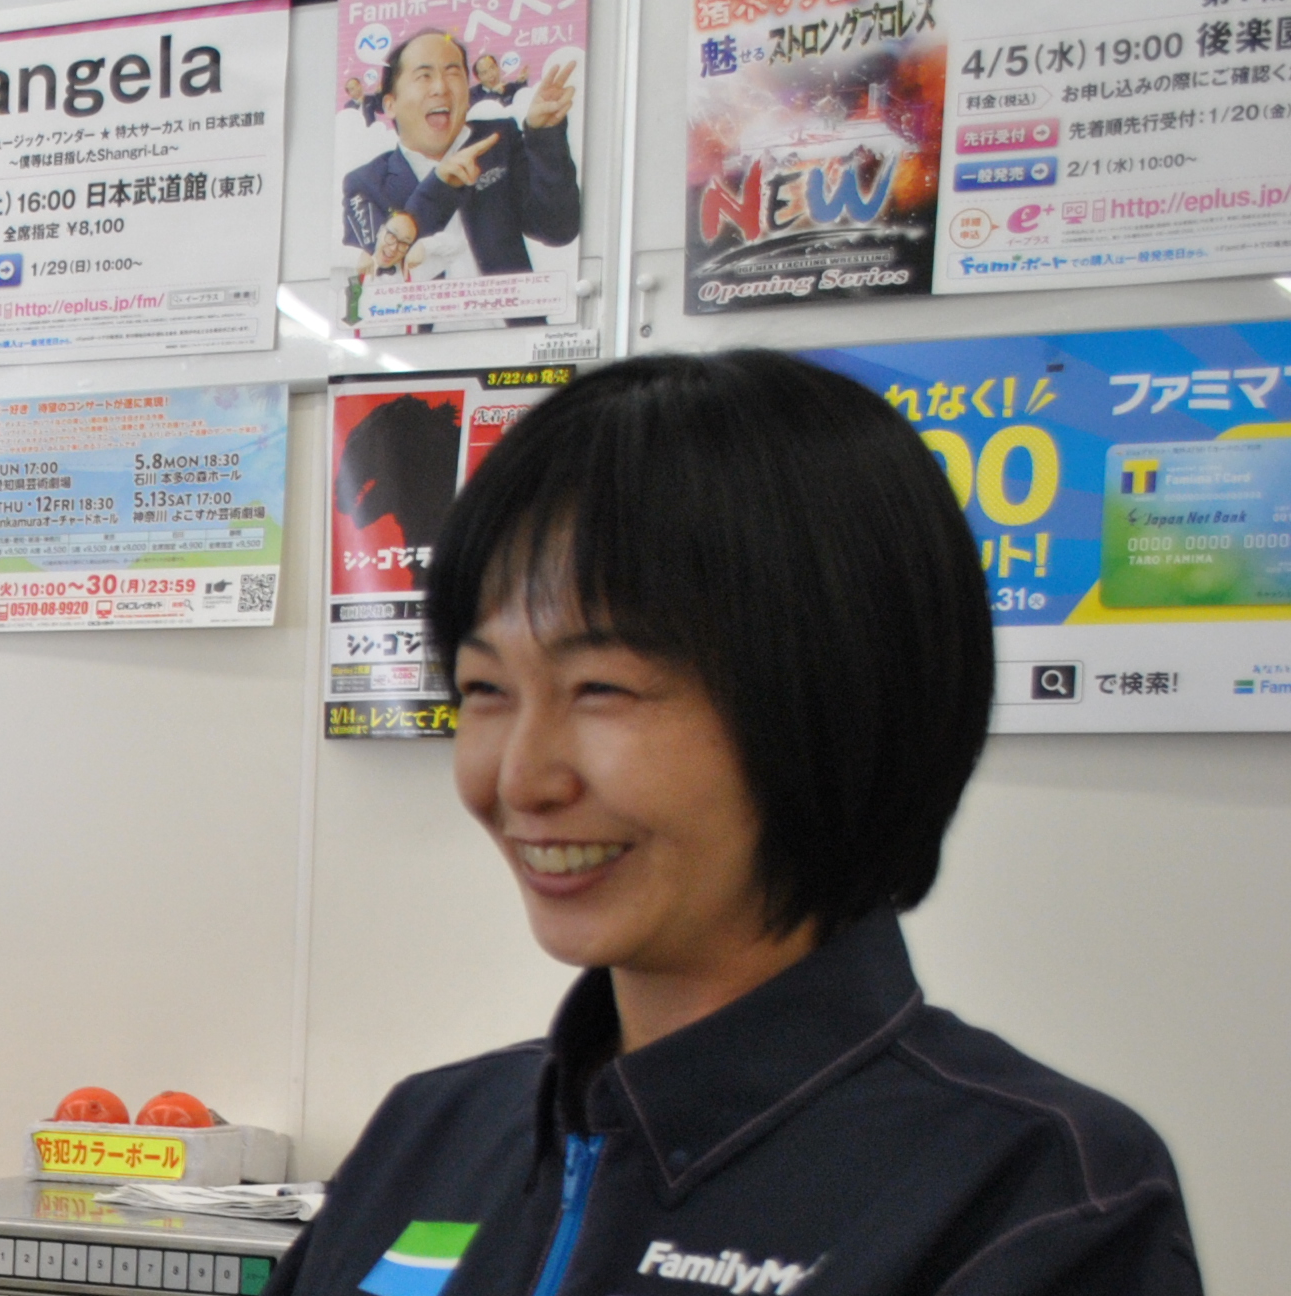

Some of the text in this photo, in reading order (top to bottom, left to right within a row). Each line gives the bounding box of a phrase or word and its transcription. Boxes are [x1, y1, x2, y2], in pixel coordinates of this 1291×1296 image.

[514, 25, 573, 47] と購入!
[700, 35, 765, 78] 魅せる
[1095, 32, 1183, 66] 19:00
[966, 62, 1291, 110] 料金(税込) お申し込みの際にご確認く
[116, 120, 184, 140] 特大サーカス
[205, 111, 266, 131] 日本武道館
[964, 129, 1026, 146] 先行受付
[961, 168, 1025, 183] 一般発売
[18, 189, 76, 214] 16:00
[700, 147, 898, 246] NEW
[3, 218, 125, 243] 全席指定 ¥8,100
[698, 268, 909, 303] Opening Series
[14, 293, 165, 318] http://eplus.jp/fm/
[24, 461, 58, 474] 17:00
[204, 453, 239, 467] 18:30
[134, 470, 242, 486] 石川 本多の森ホール
[79, 497, 113, 510] 18:30
[197, 492, 232, 505] 17:00
[133, 506, 265, 523] 神奈川 よこすか芸術劇場
[1143, 510, 1247, 528] Japan Net Bank
[1127, 535, 1231, 552] 0000 0000
[343, 546, 431, 571] シン・ゴジラ
[1165, 554, 1213, 565] FAMIMA
[10, 601, 89, 616] 0570-08-9920
[1095, 671, 1178, 697] で検索!
[35, 1137, 181, 1170] 防犯カラーボール
[0, 1252, 5, 1261] 1
[24, 1253, 30, 1263] 2
[48, 1255, 54, 1265] 3
[72, 1258, 79, 1267] 4
[97, 1259, 103, 1268] 5
[122, 1261, 128, 1271] 6
[147, 1264, 154, 1272] 7
